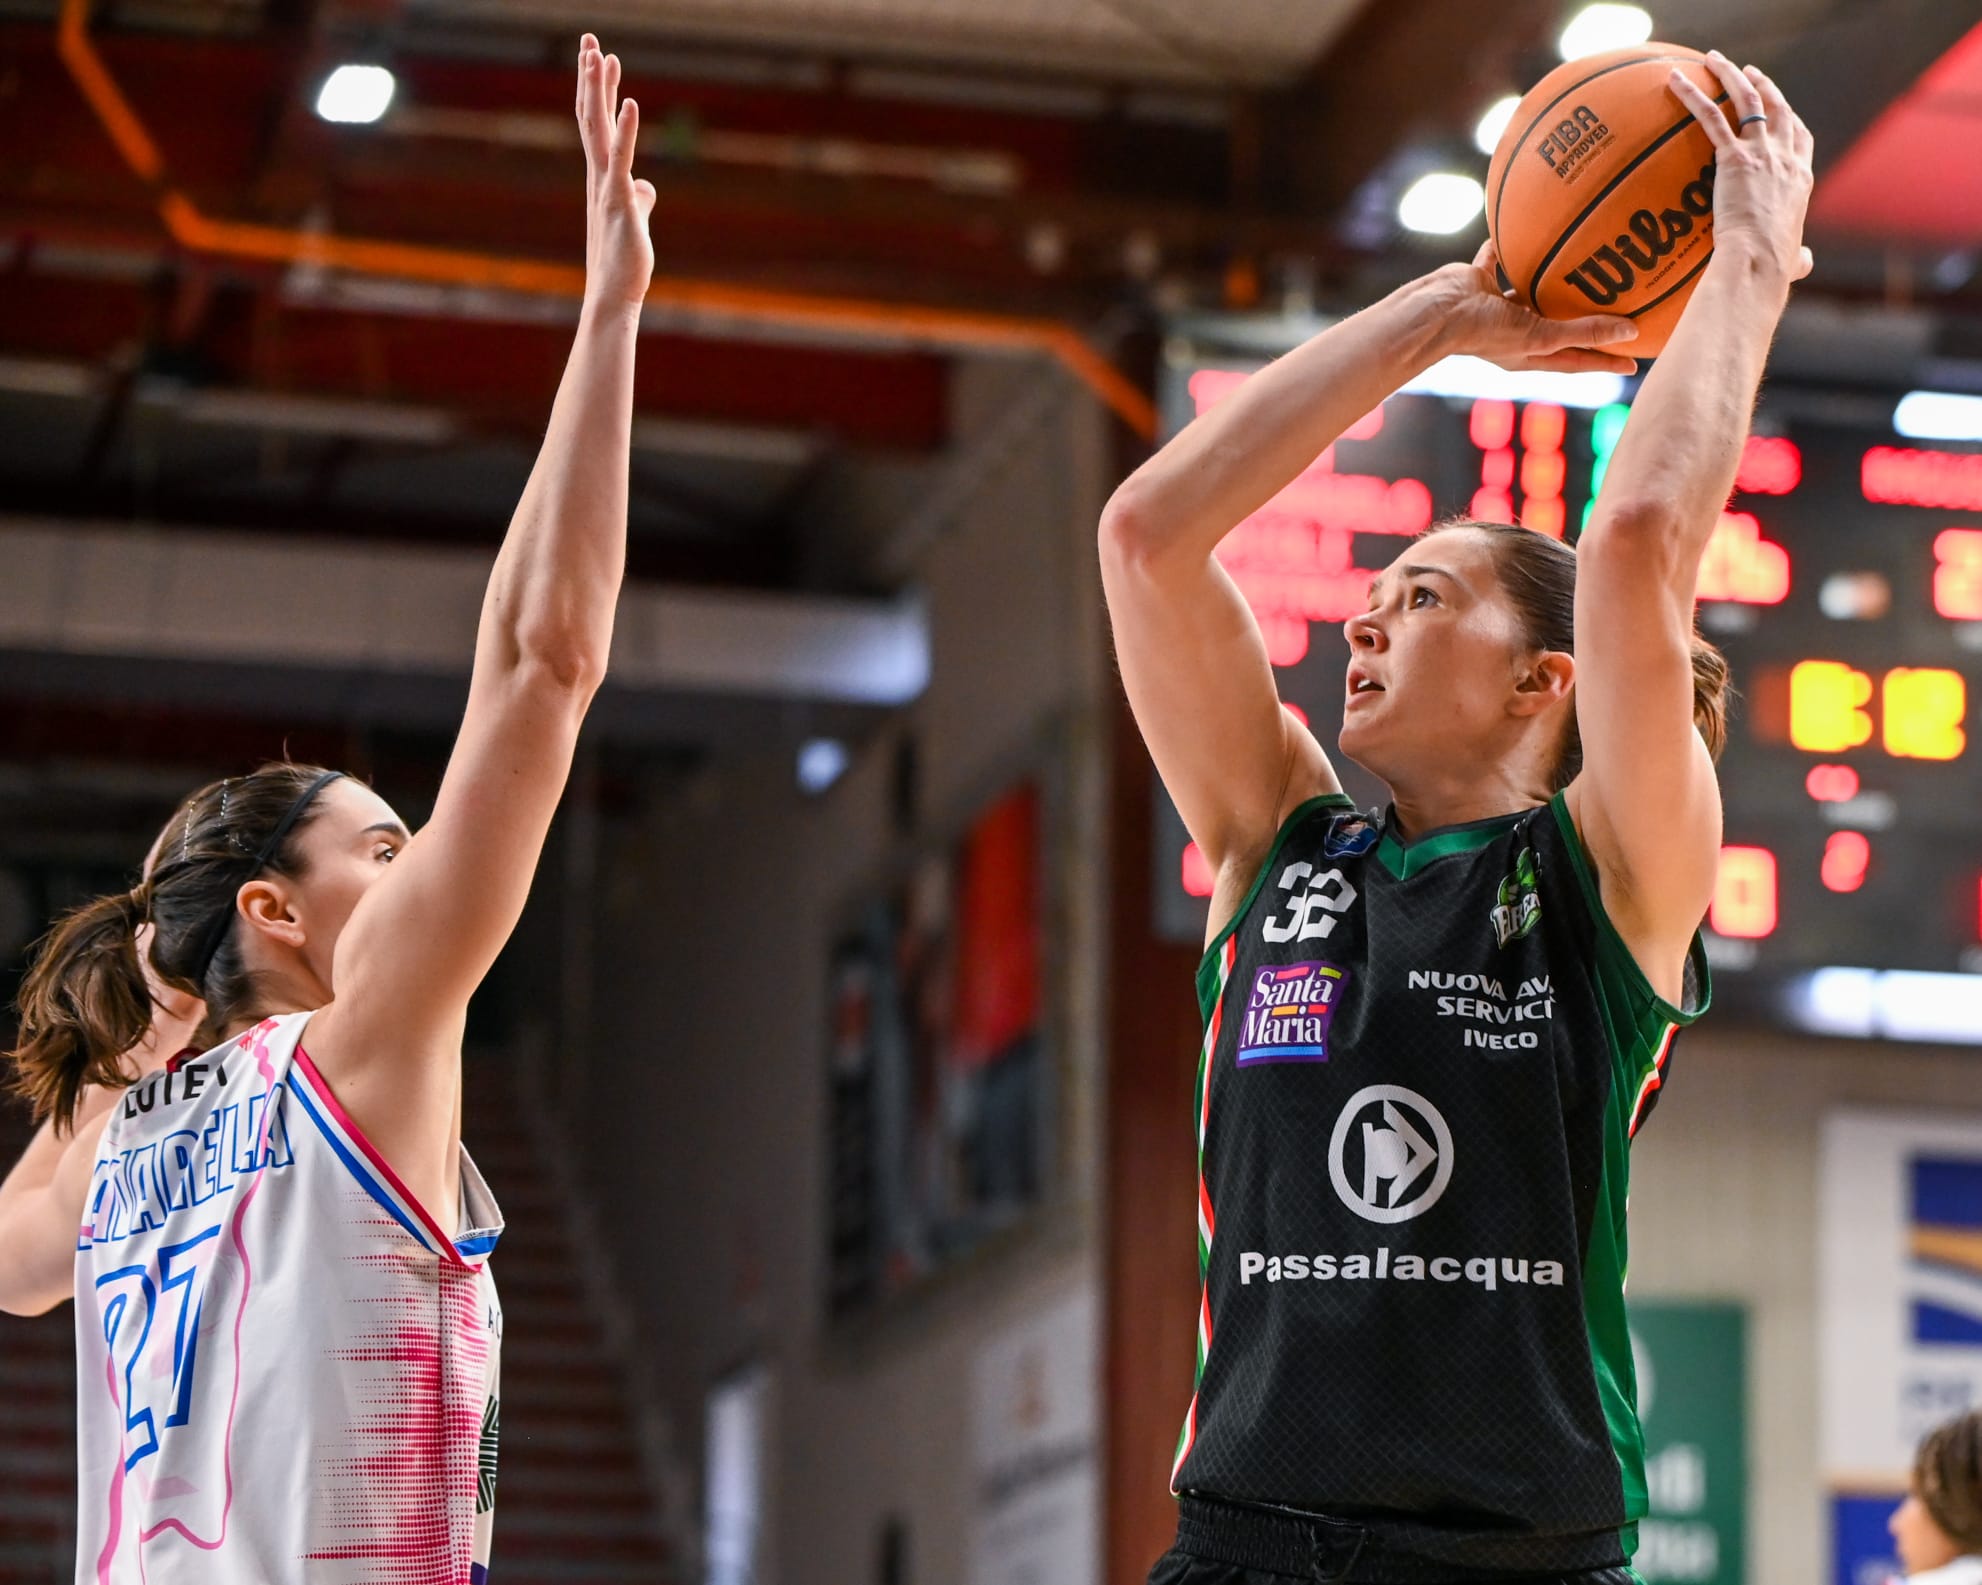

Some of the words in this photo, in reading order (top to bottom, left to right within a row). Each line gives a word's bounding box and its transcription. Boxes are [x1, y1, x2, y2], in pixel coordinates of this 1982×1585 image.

[1538, 105, 1599, 168] FIBA
[1556, 124, 1609, 179] APPROVED
[1262, 861, 1358, 943] 32
[1251, 969, 1332, 1008] Santa
[1408, 970, 1508, 1001] NUOVA
[1239, 1005, 1323, 1049] Maria
[1463, 1028, 1539, 1050] IVECO
[1239, 1247, 1565, 1291] Passalacqua
[95, 1223, 222, 1477] 27
